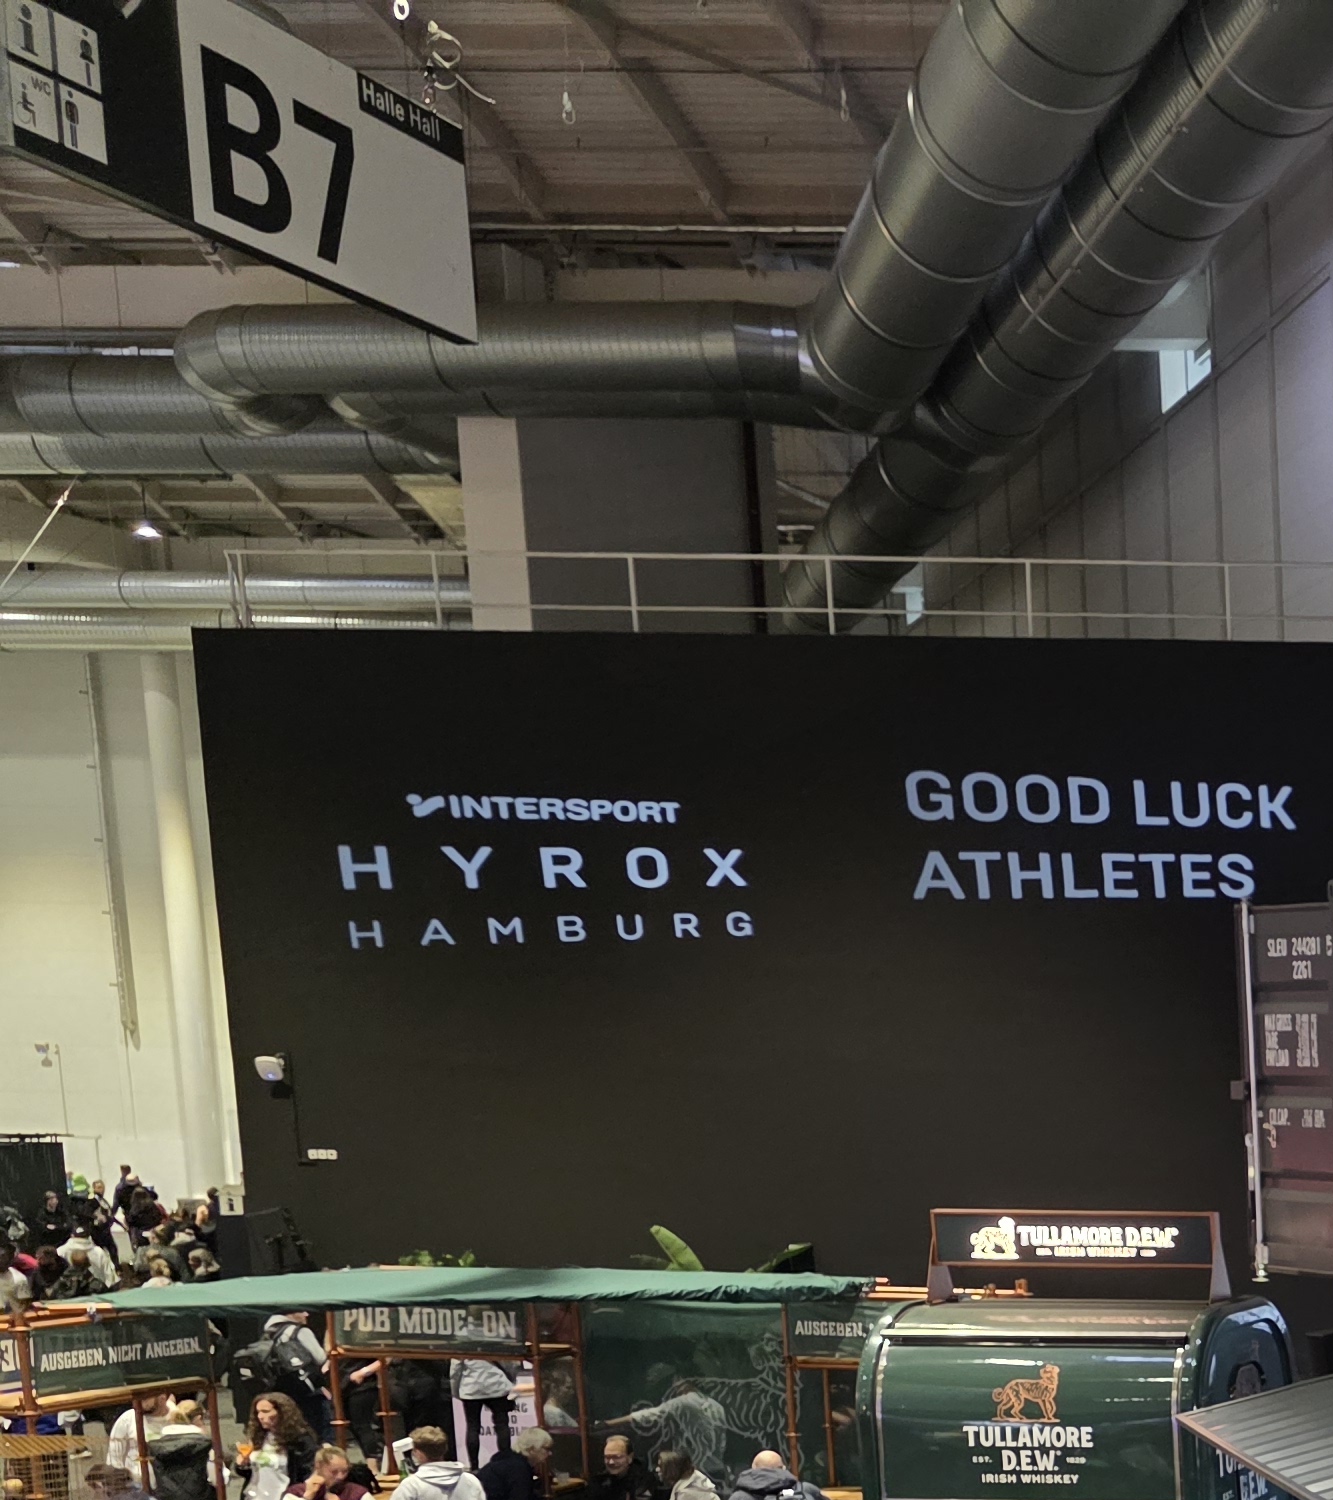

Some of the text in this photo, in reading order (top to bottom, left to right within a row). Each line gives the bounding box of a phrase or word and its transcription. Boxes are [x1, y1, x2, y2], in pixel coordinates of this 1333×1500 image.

[362, 78, 440, 142] Halle Hall
[200, 44, 354, 264] B7
[449, 795, 681, 823] INTERSPORT
[904, 769, 1297, 830] GOOD LUCK
[337, 845, 748, 890] HYROX
[913, 850, 1255, 900] ATHLETES
[348, 911, 754, 948] HAMBURG
[1016, 1225, 1123, 1247] TULLAMORE
[343, 1306, 391, 1332] PUB
[481, 1310, 517, 1339] ON
[40, 1348, 106, 1373] AUSGEBEN,
[108, 1343, 142, 1364] NICHT
[962, 1425, 1094, 1448] TULLAMORE
[972, 1455, 993, 1464] EST.
[981, 1473, 1079, 1484] IRISH WHISKEY
